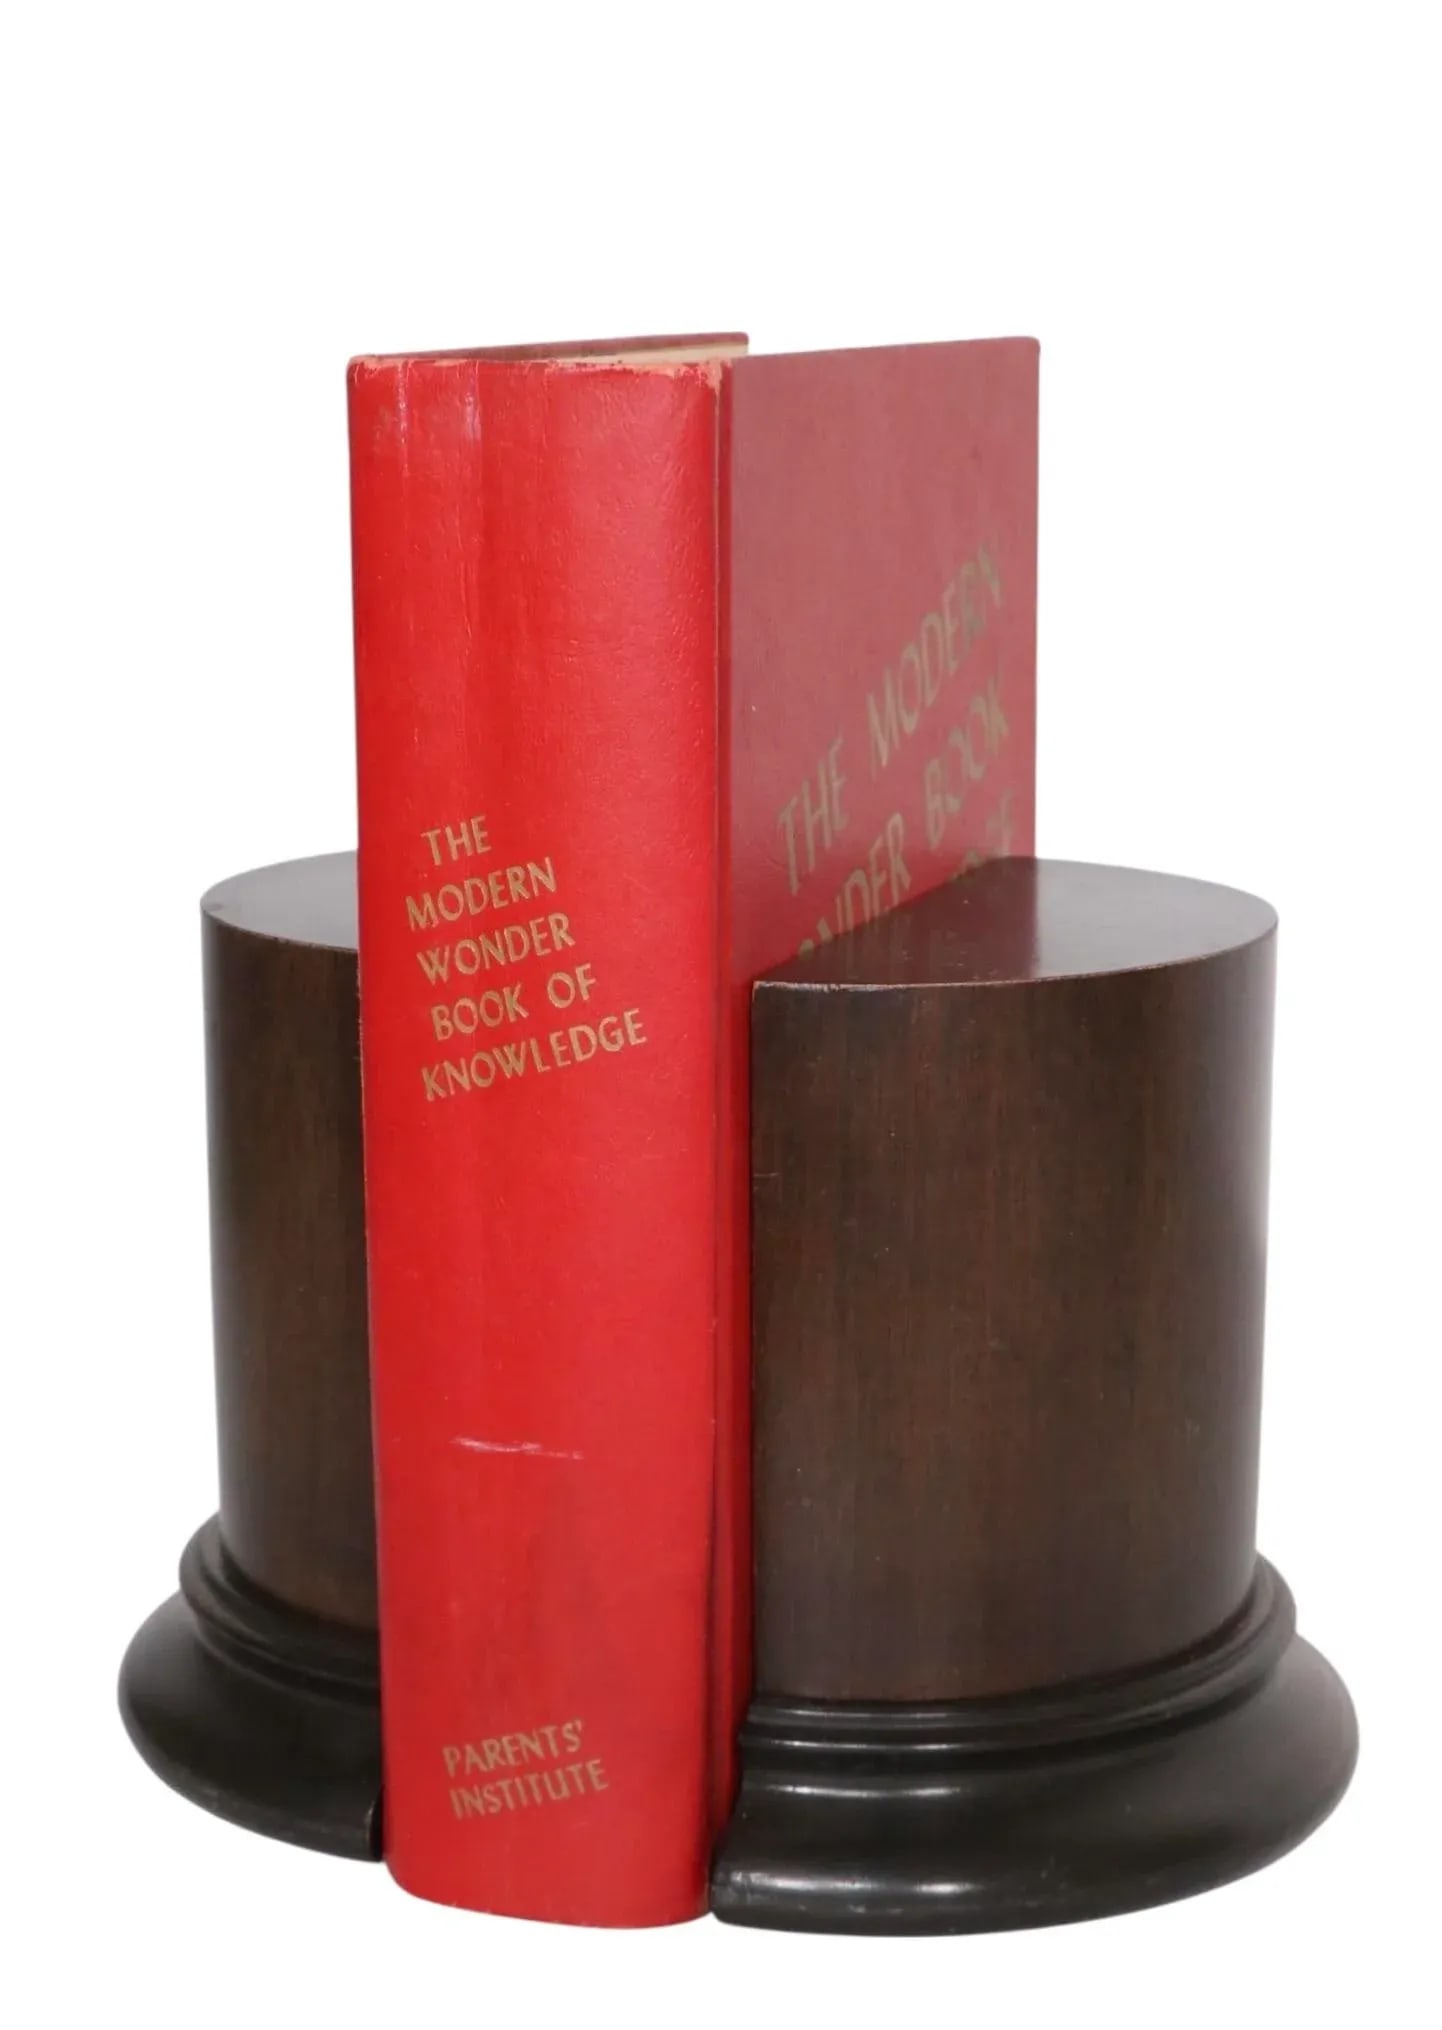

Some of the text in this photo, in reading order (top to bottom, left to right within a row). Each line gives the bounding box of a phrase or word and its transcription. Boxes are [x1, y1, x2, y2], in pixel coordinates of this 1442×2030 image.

[777, 733, 849, 896] THE
[866, 539, 1004, 777] MODERN
[925, 672, 1009, 852] BOOK
[420, 815, 492, 866] THE
[405, 856, 557, 932] MODERN
[416, 912, 576, 986] WONDER
[431, 963, 596, 1041] BOOK OF
[421, 1008, 647, 1102] KNOWLEDGE
[442, 1719, 583, 1778] PARENTS'
[449, 1758, 609, 1820] INSTITUTE
